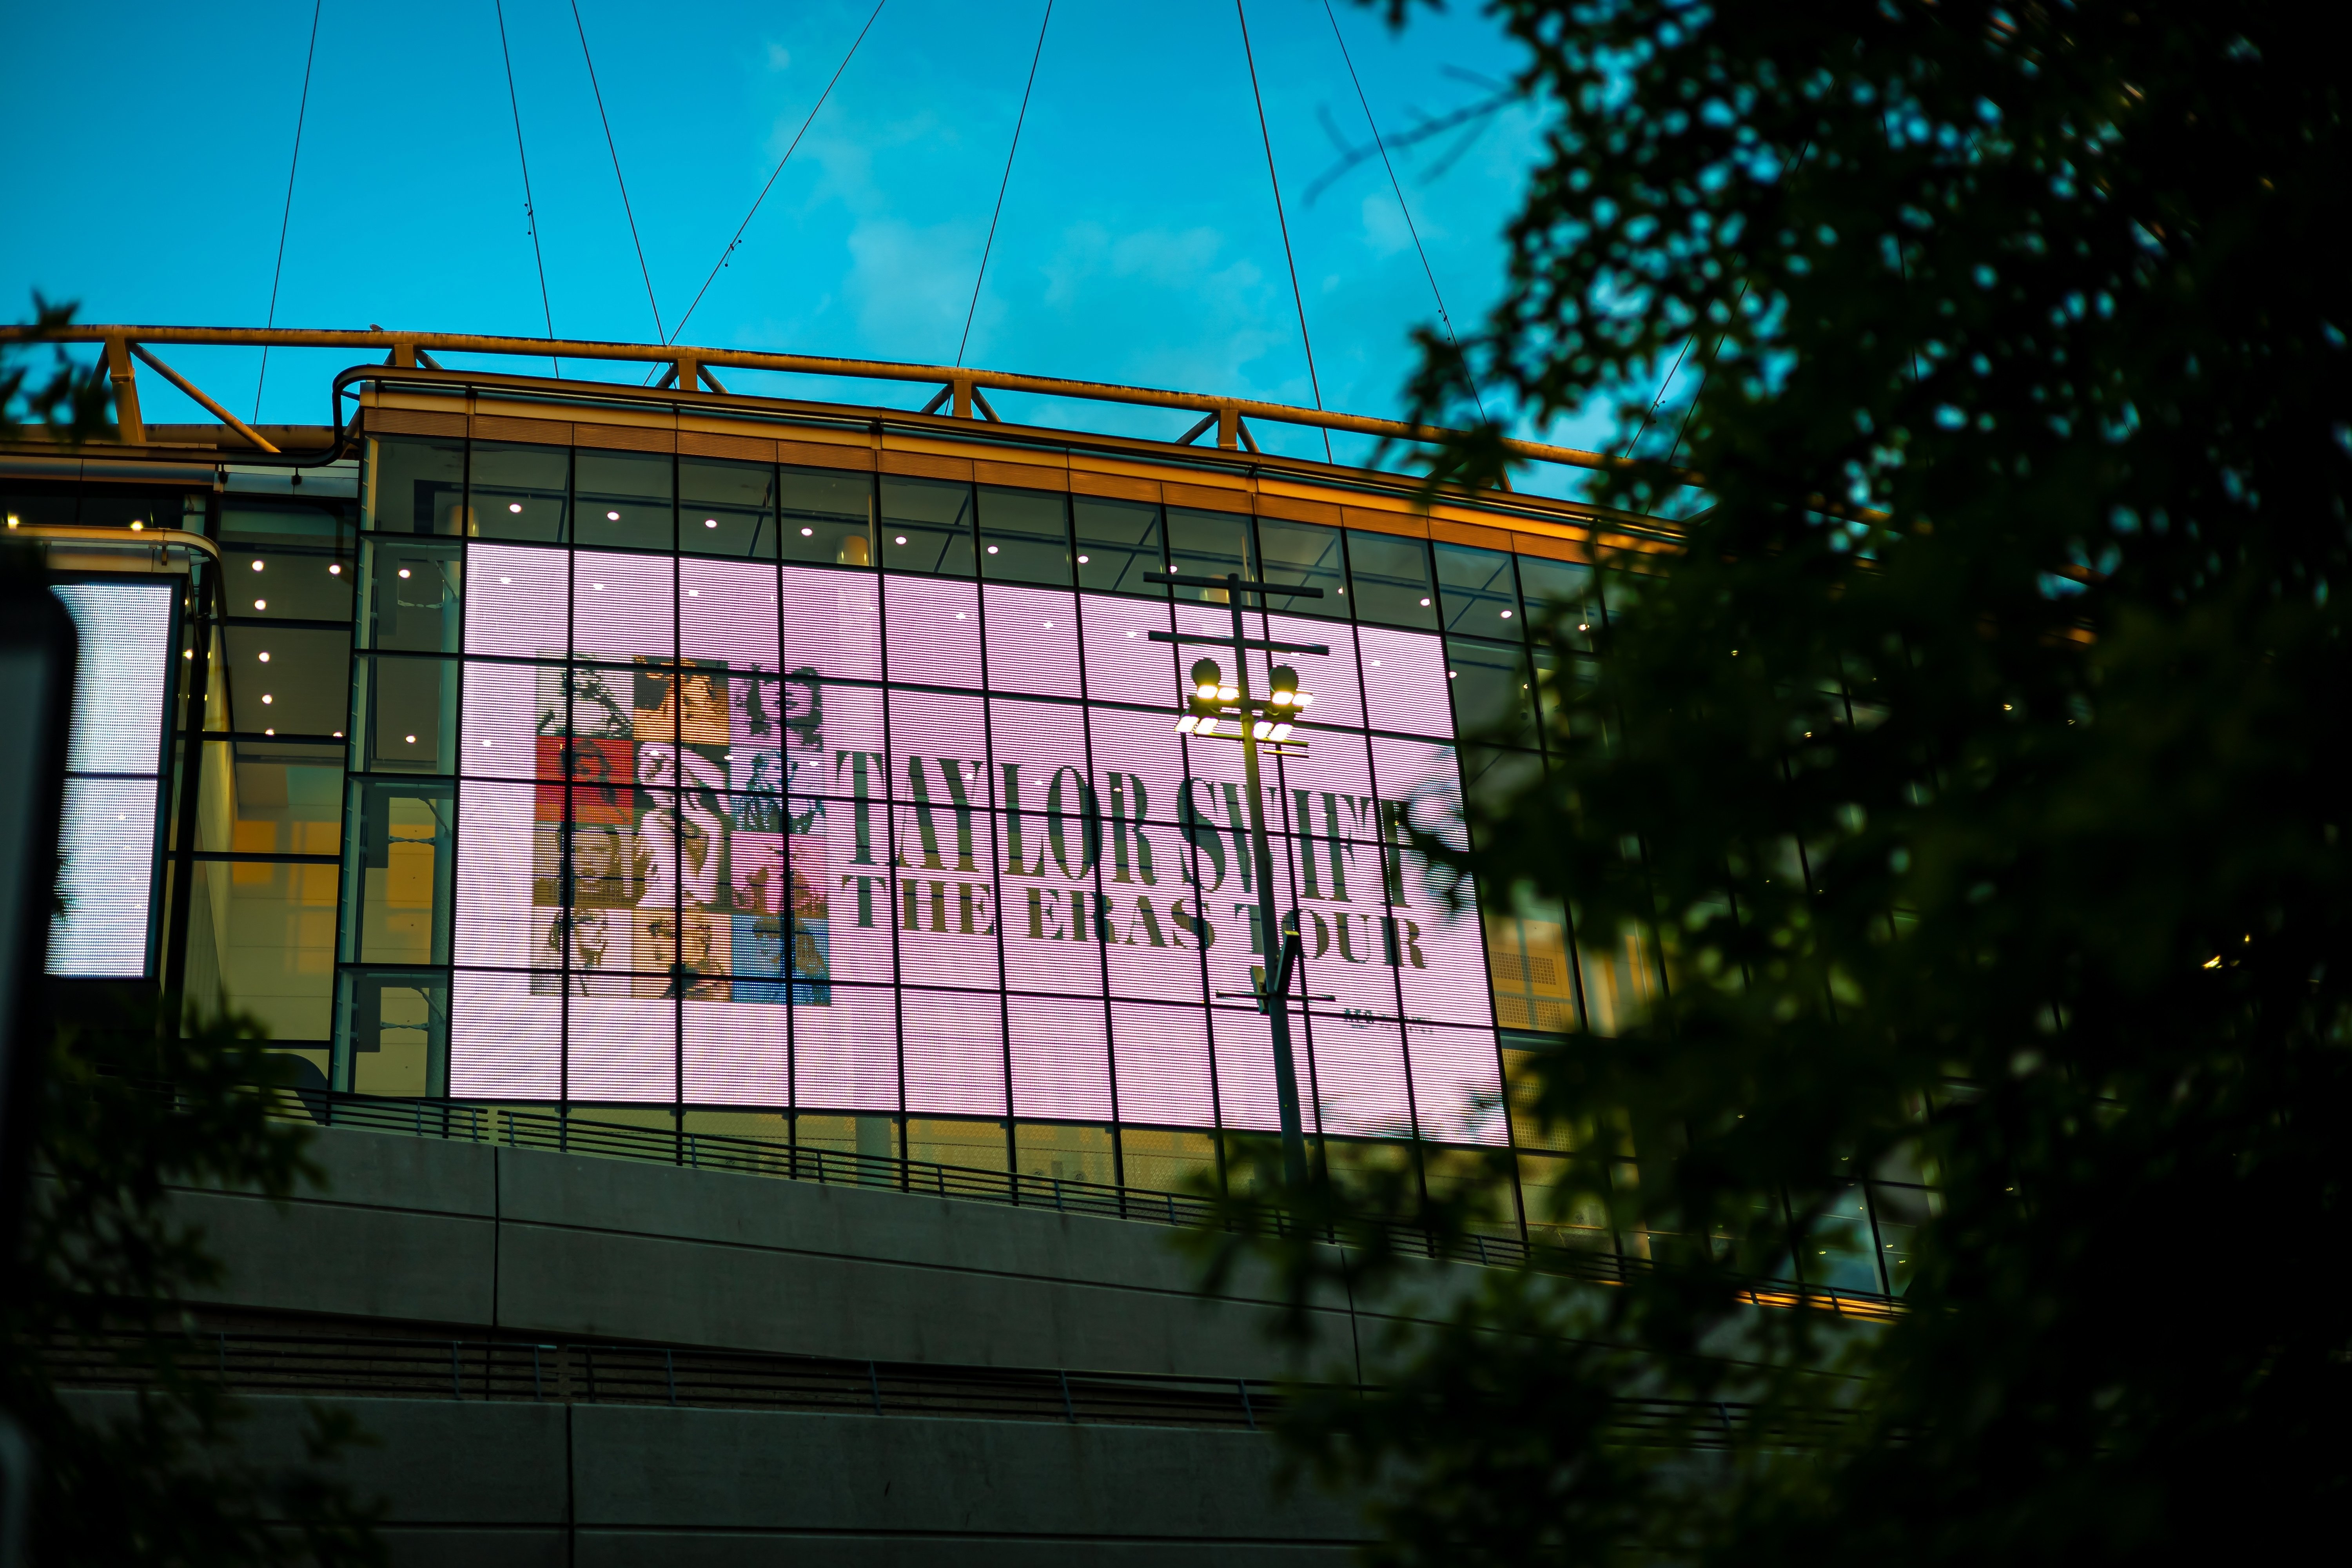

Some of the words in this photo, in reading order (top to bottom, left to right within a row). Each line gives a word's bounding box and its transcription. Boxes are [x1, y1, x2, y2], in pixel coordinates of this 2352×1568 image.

[835, 751, 1158, 886] TAYLOR
[842, 875, 995, 935] THE
[1026, 887, 1215, 950] ERAS
